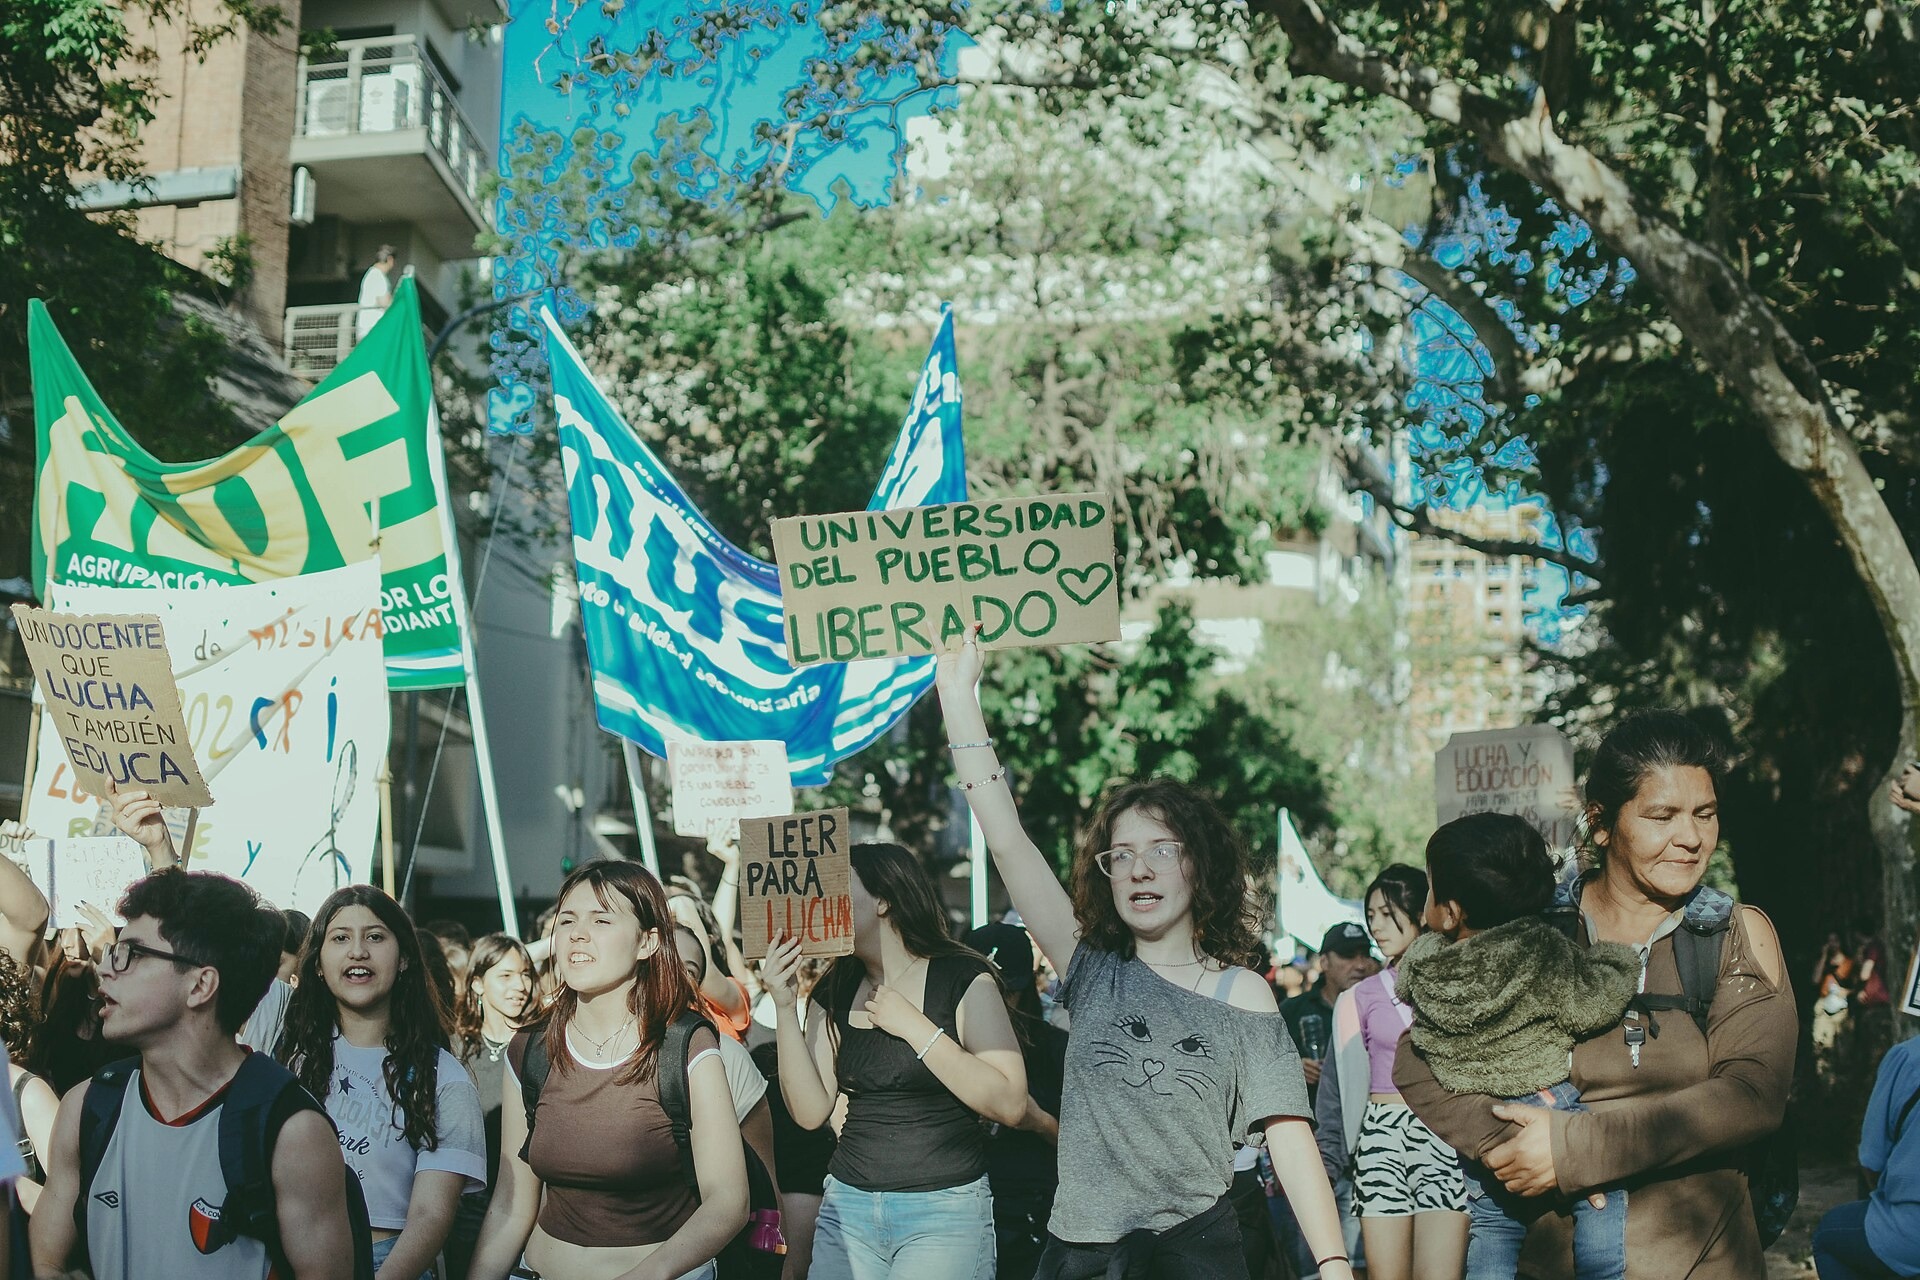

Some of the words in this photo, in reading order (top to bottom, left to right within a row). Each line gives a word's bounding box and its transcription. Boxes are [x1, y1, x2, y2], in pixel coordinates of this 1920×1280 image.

[800, 500, 1105, 551] UNIVERSIDAD
[790, 555, 857, 589] DEL
[876, 538, 1060, 586] PUEBLO
[381, 587, 412, 612] OR
[413, 574, 448, 604] LO
[18, 616, 49, 643] UN
[48, 622, 162, 650] DOCENTE
[789, 590, 1057, 663] LIBERADO
[61, 654, 113, 677] QUE
[46, 668, 155, 712] LUCHA
[66, 712, 176, 745] TAMBIÉN
[65, 736, 190, 785] EDUCA
[1454, 744, 1509, 770] LUCHA
[1517, 741, 1532, 765] Y
[1456, 760, 1553, 793] EDUCACIÓN
[768, 814, 837, 858] LEER
[747, 859, 824, 898] PARA
[767, 894, 852, 945] LUCHAR
[338, 1129, 371, 1156] ork
